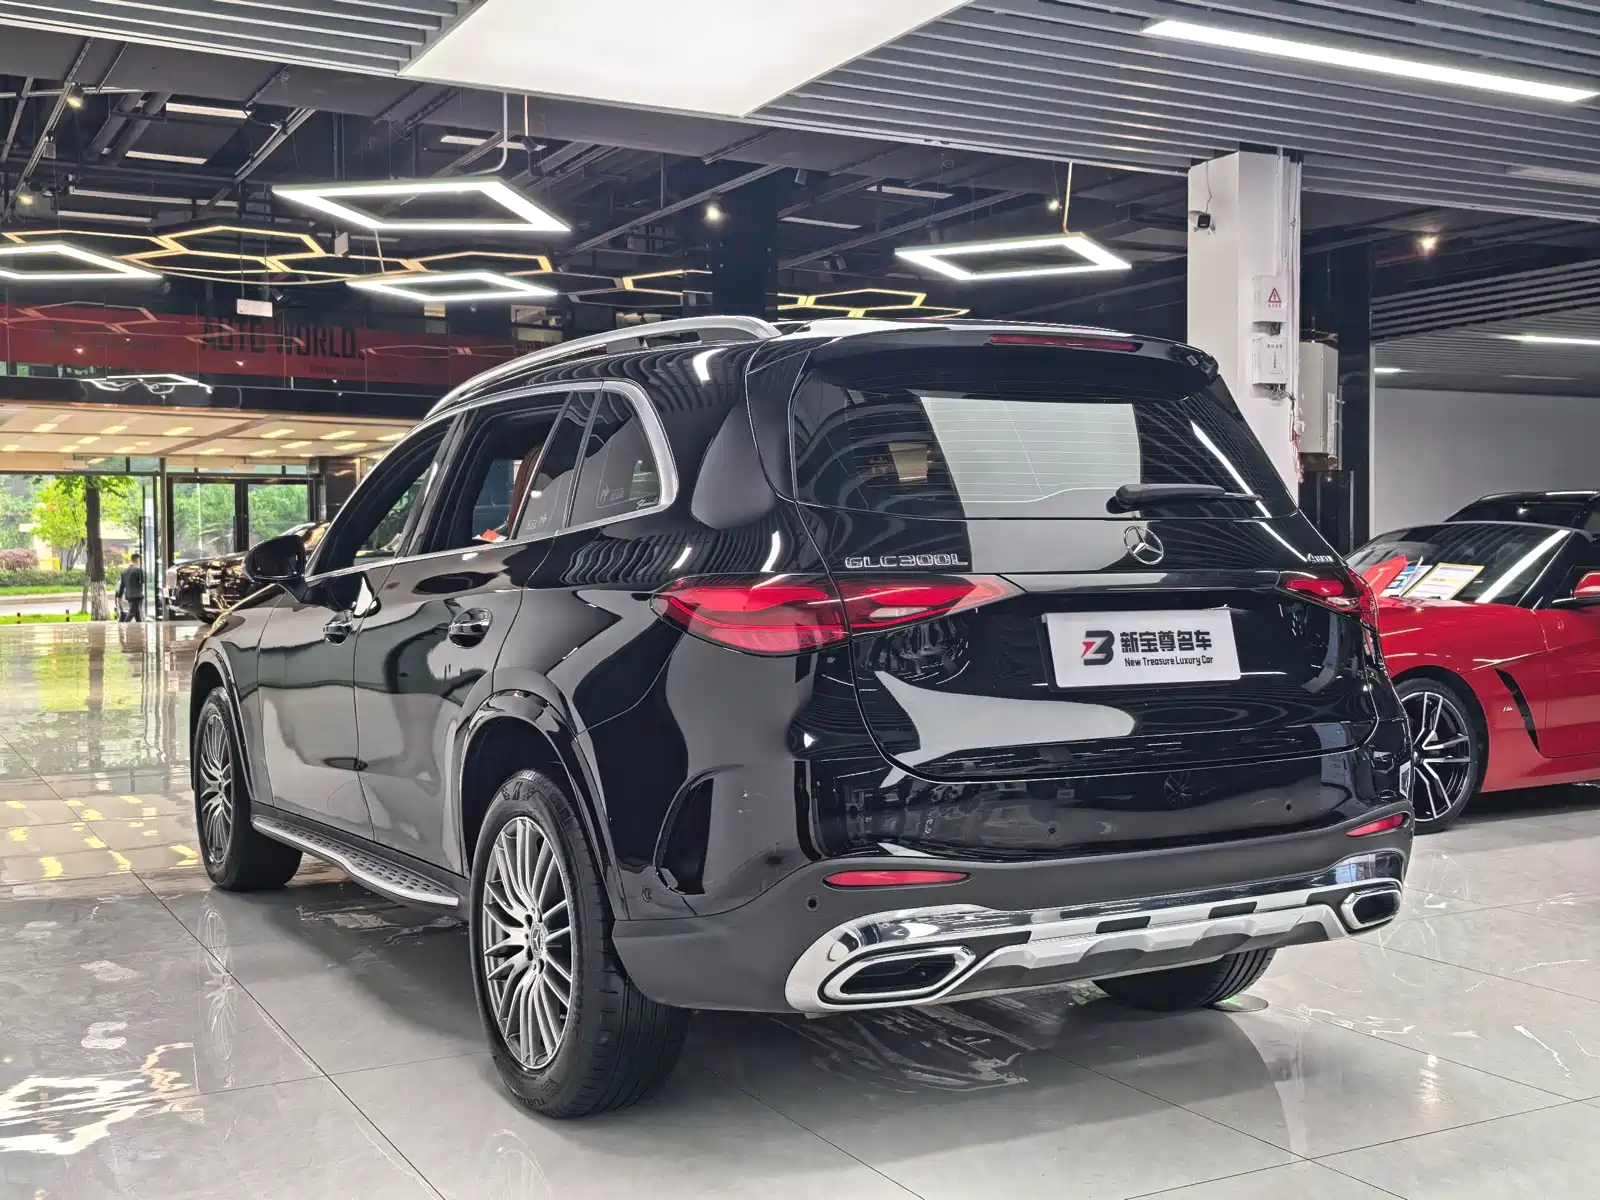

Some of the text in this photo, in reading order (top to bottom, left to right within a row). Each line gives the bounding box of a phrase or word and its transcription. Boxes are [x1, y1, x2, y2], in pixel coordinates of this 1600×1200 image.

[844, 553, 968, 569] GLC300L
[1120, 629, 1213, 654] 新宝尊名车
[1124, 655, 1214, 667] New Treasure Luxury Car
